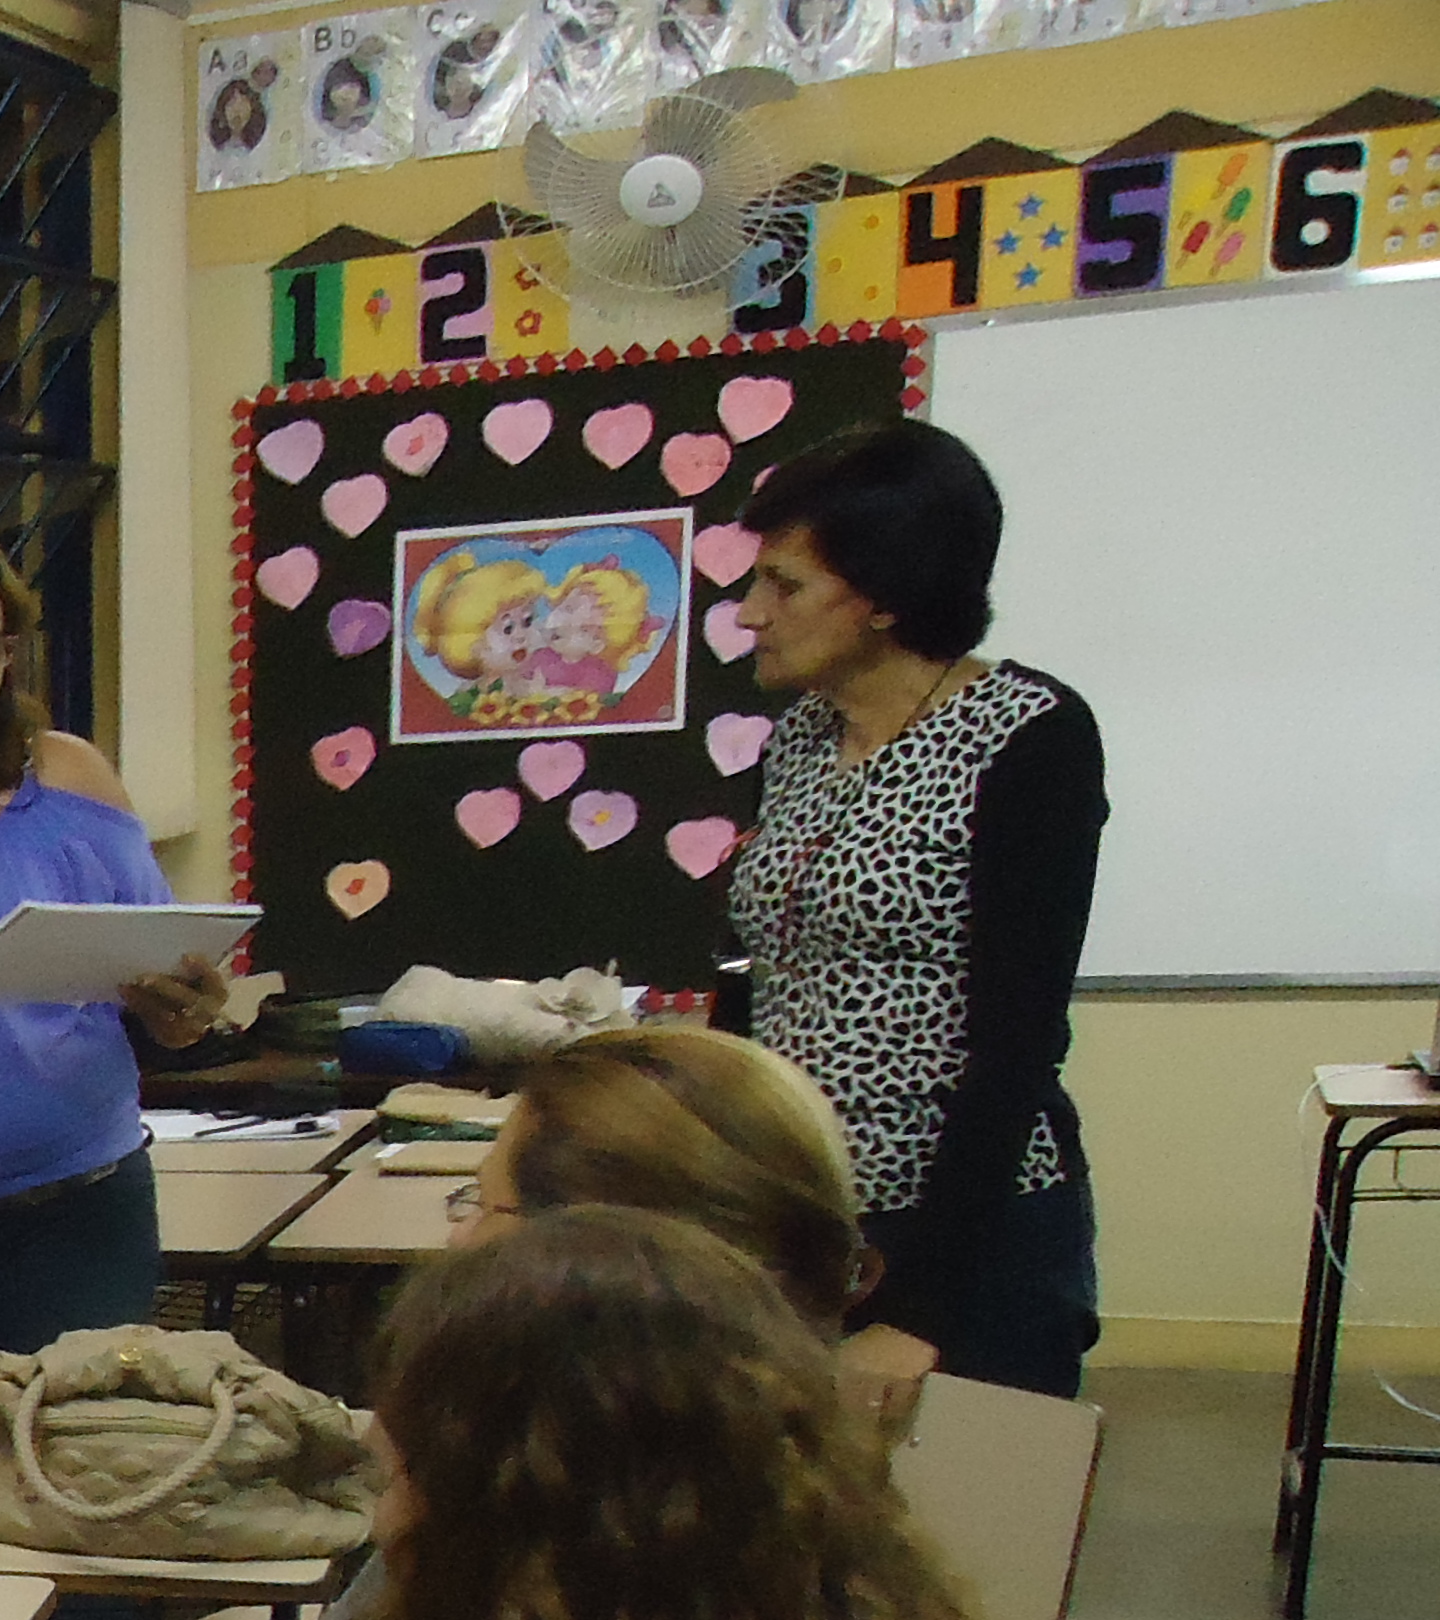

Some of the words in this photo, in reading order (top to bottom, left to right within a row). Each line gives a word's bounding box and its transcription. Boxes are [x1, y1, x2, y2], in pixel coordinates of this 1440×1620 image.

[315, 25, 332, 53] B
[284, 271, 327, 383] 1
[421, 247, 487, 364] 2
[734, 212, 809, 333] 3
[904, 185, 986, 307] 4
[1081, 160, 1170, 292] 5
[1270, 139, 1367, 272] 6
